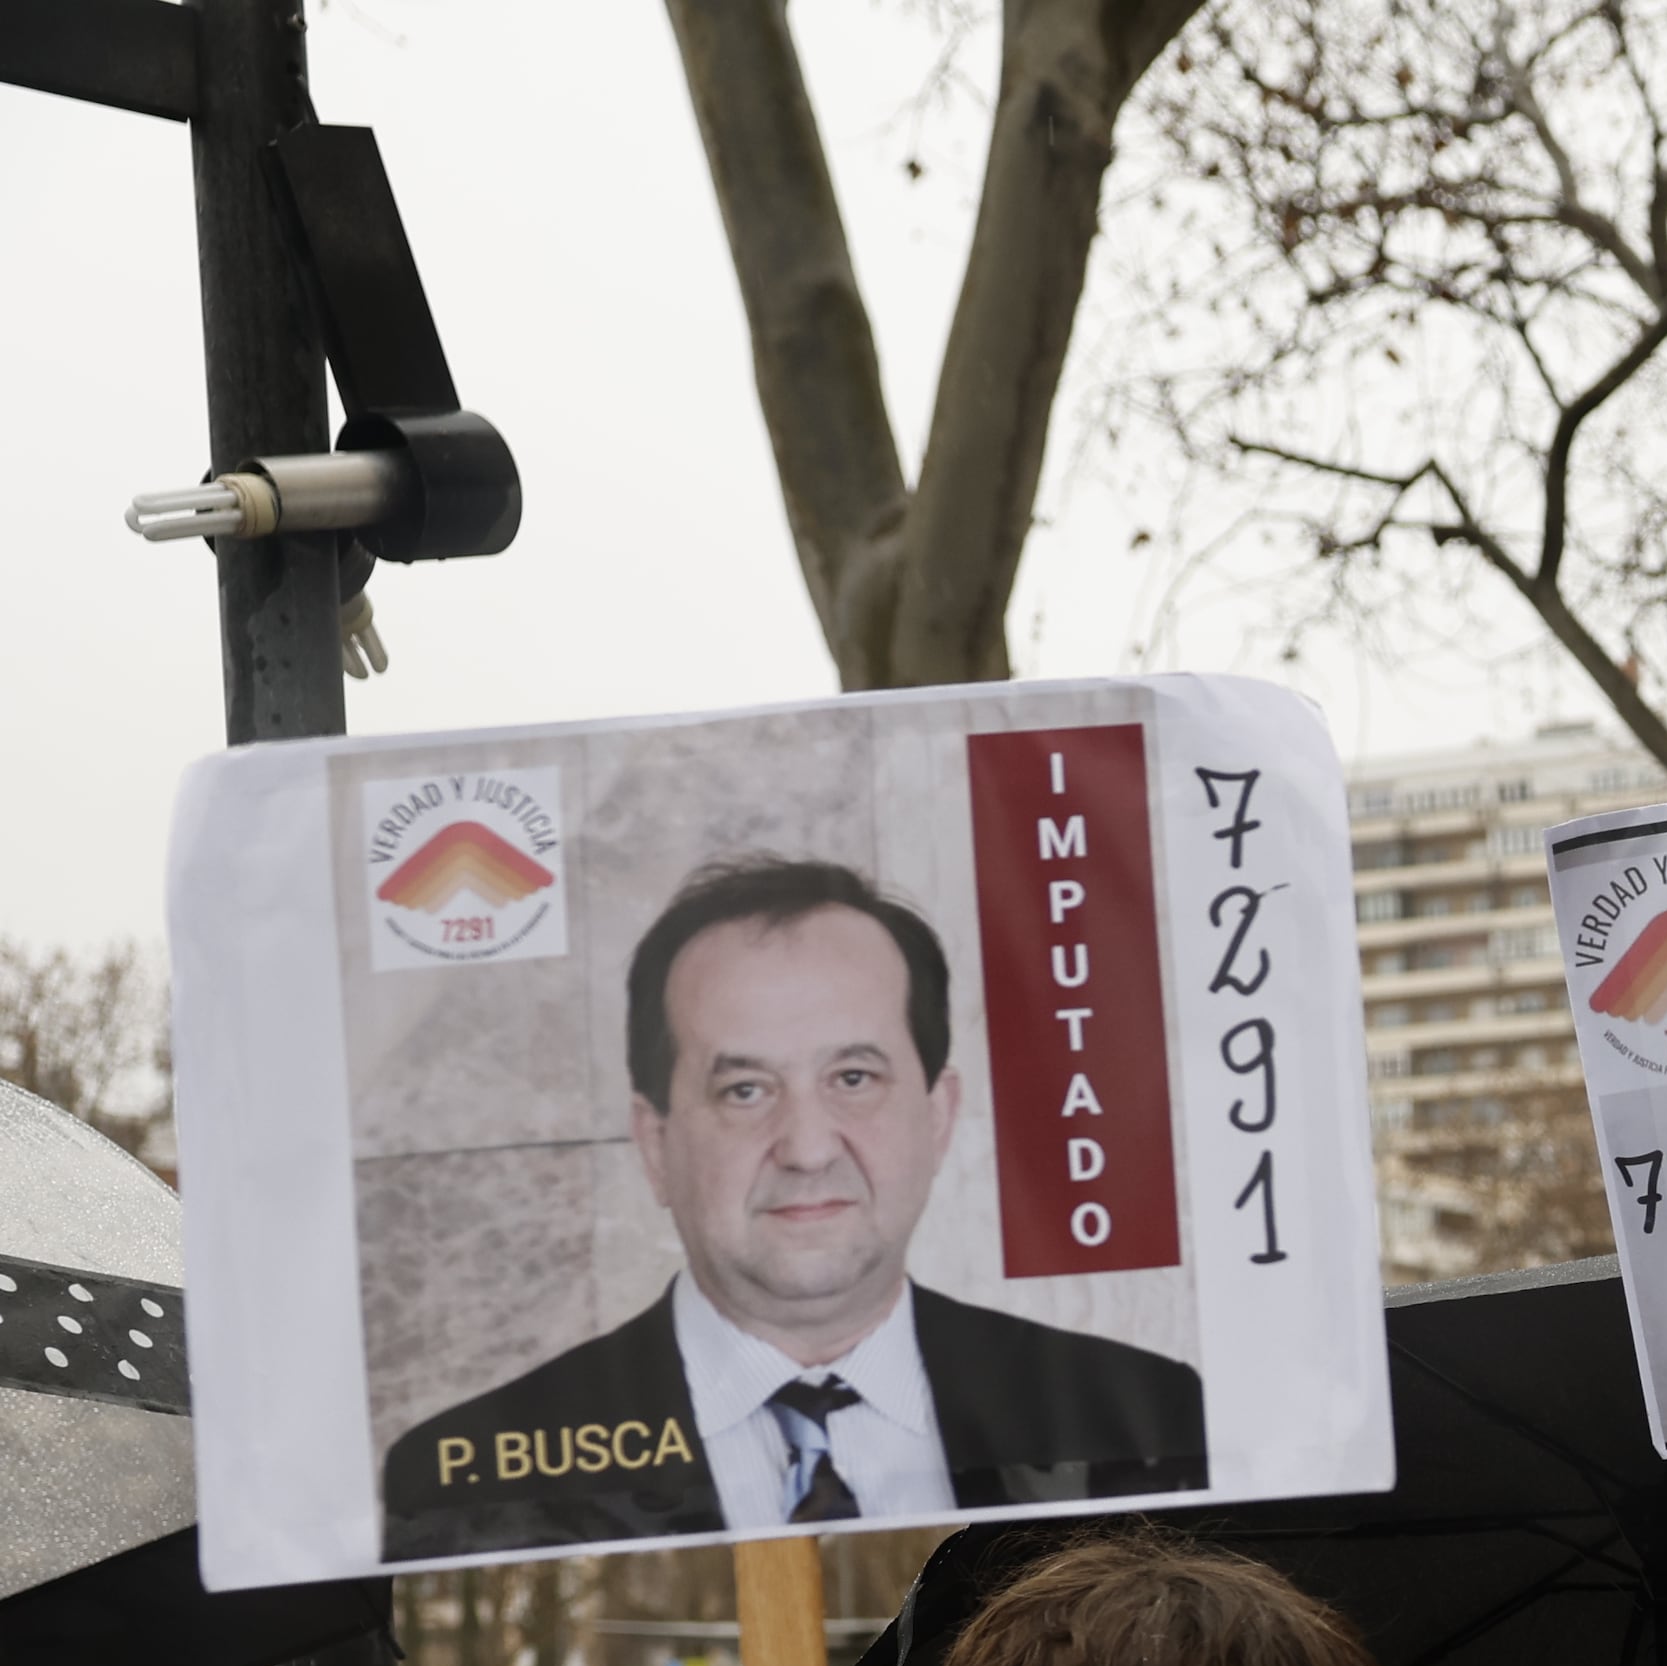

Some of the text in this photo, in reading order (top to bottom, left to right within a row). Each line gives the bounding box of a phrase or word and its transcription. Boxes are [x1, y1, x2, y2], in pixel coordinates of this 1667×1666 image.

[369, 776, 559, 864] VERDAD Y JUSTICIA
[441, 917, 494, 942] 7291
[1575, 866, 1648, 968] VERDAD
[1653, 855, 1667, 885] Y
[1037, 752, 1112, 1246] IMPUTADO
[1194, 767, 1288, 1264] 7291
[437, 1417, 694, 1485] P. BUSCA
